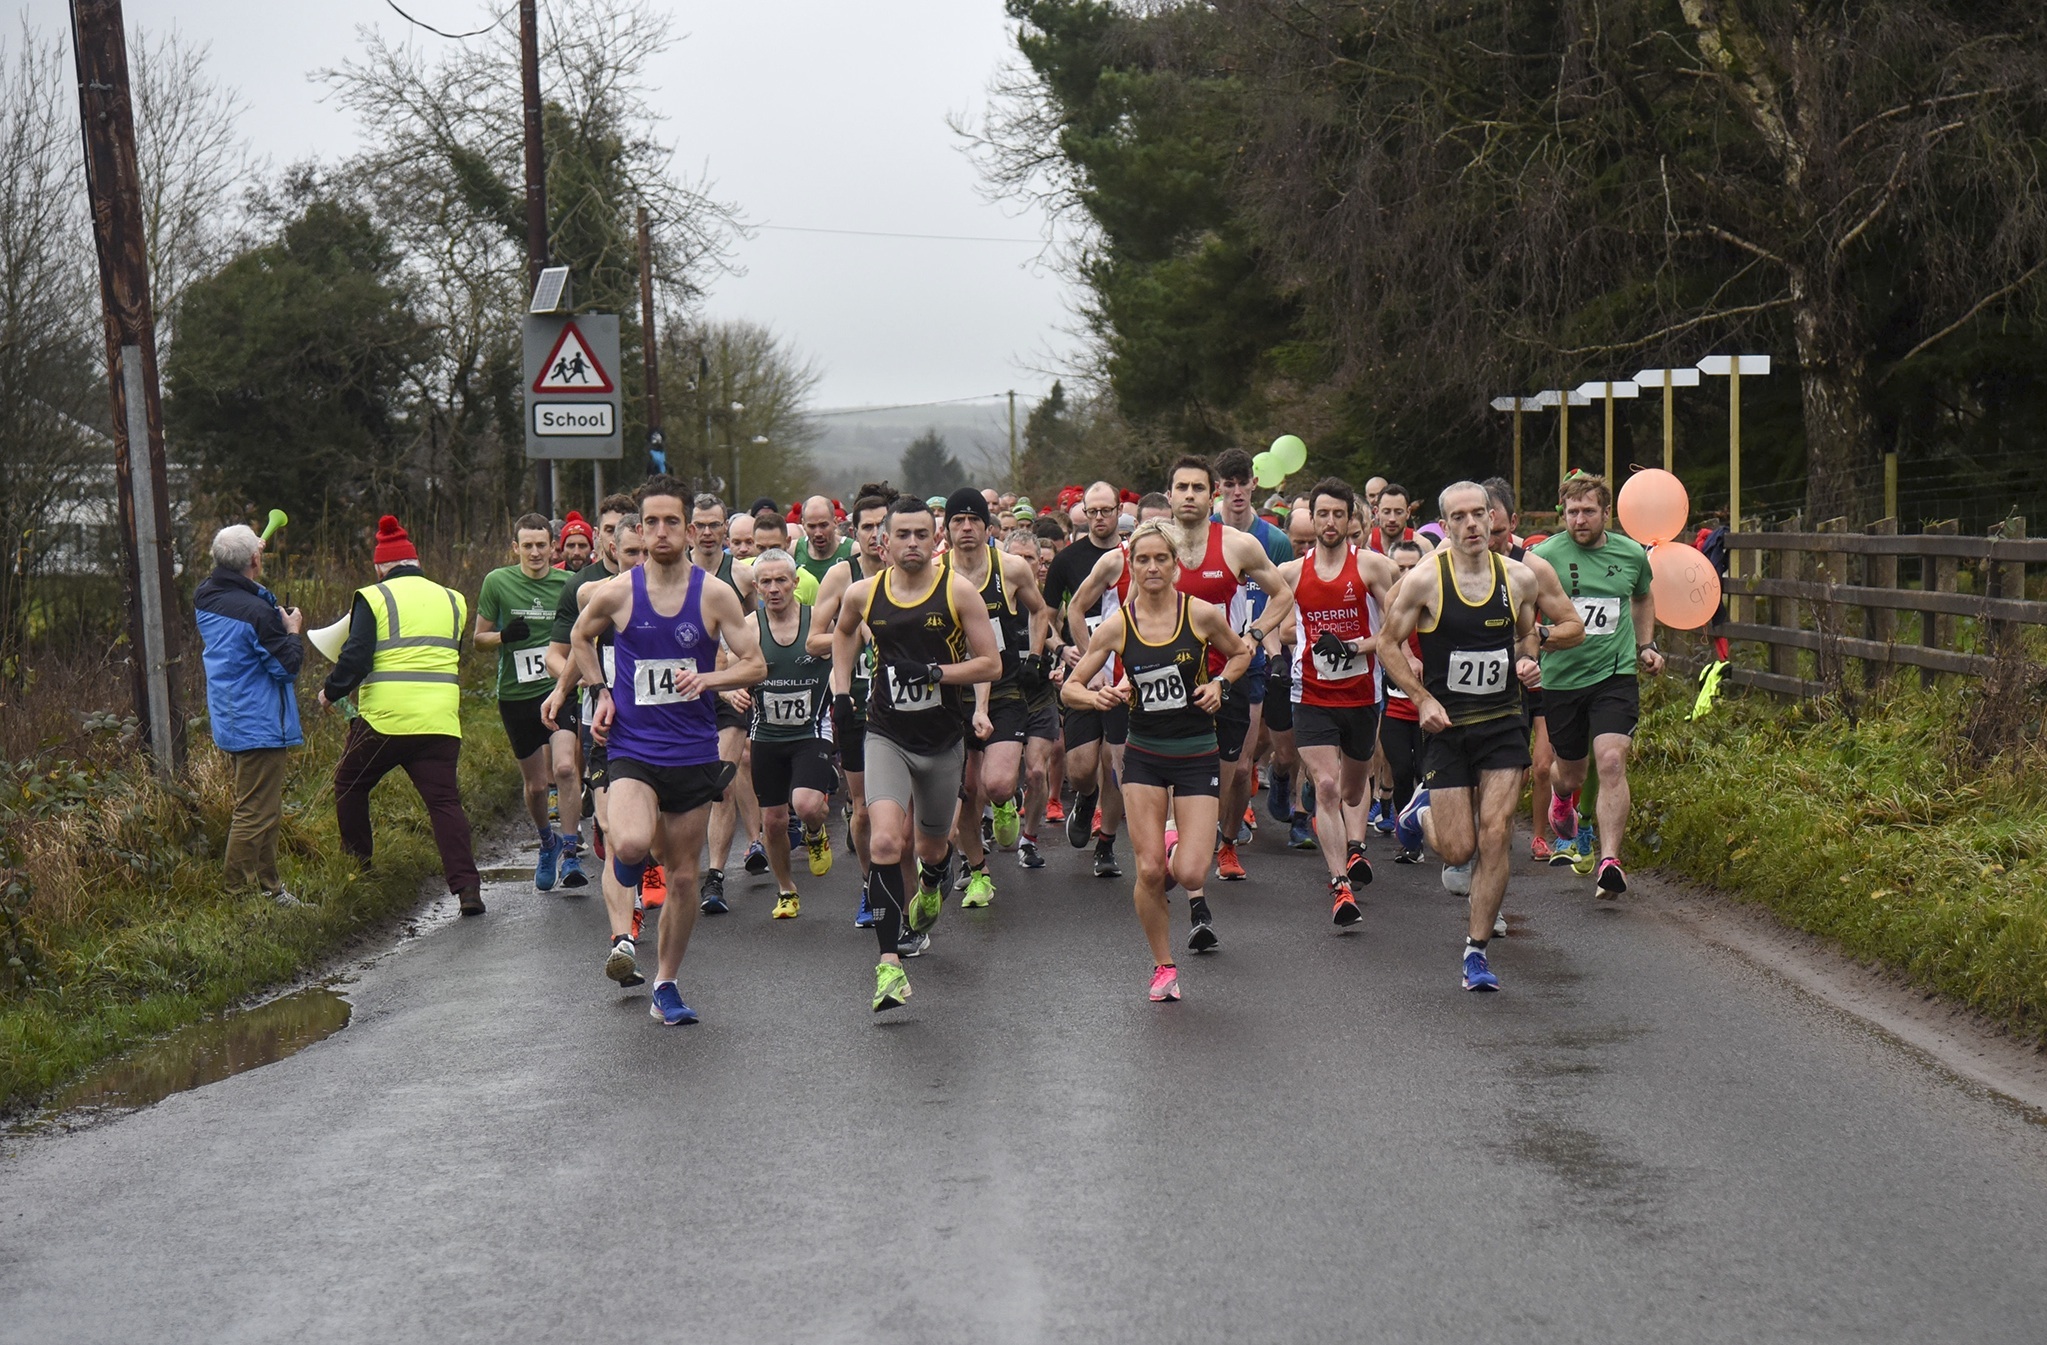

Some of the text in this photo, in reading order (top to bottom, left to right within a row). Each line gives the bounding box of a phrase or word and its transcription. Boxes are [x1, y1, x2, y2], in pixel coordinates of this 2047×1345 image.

[542, 411, 606, 427] School
[1306, 607, 1359, 622] SPERRIN
[1584, 605, 1607, 628] 76
[648, 666, 687, 696] 14
[757, 677, 819, 687] NNISKILLEN
[1458, 660, 1501, 687] 213
[1140, 674, 1184, 703] 208
[774, 699, 805, 720] 178
